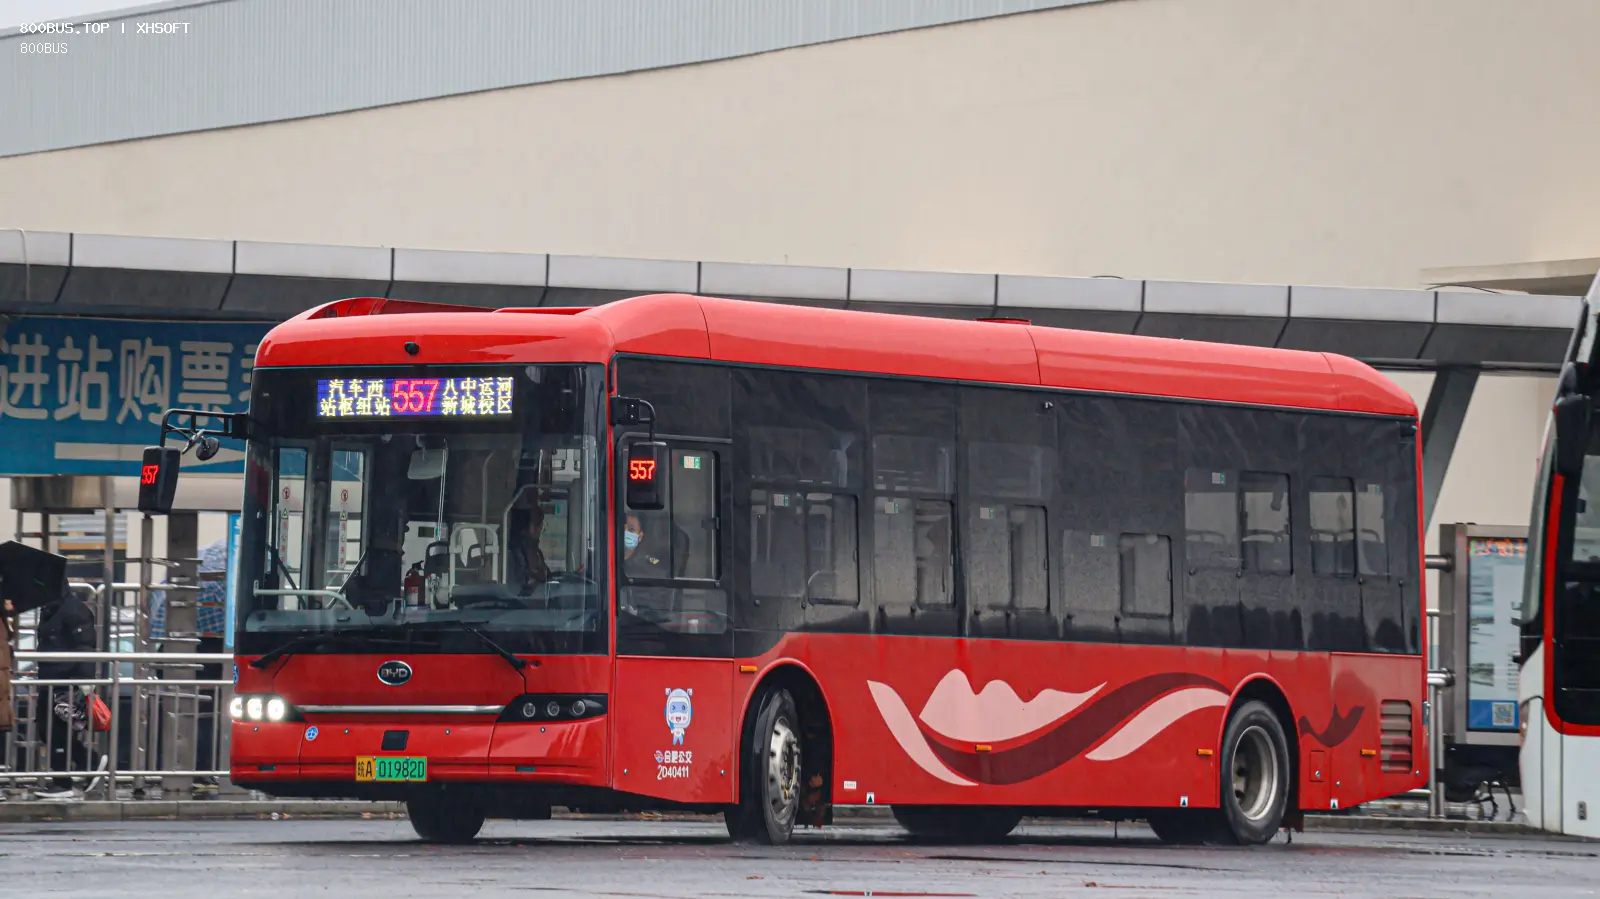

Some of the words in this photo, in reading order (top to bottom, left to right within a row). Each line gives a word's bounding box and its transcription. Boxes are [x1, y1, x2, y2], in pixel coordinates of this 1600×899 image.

[0, 332, 256, 426] 进站购票
[329, 379, 384, 398] 汽车西
[442, 377, 514, 396] 八中运河
[392, 380, 440, 412] 557
[441, 396, 513, 414] 新城校区
[319, 397, 391, 416] 站枢纽站
[141, 465, 158, 485] 557
[630, 460, 655, 480] 557
[381, 668, 408, 678] BYD
